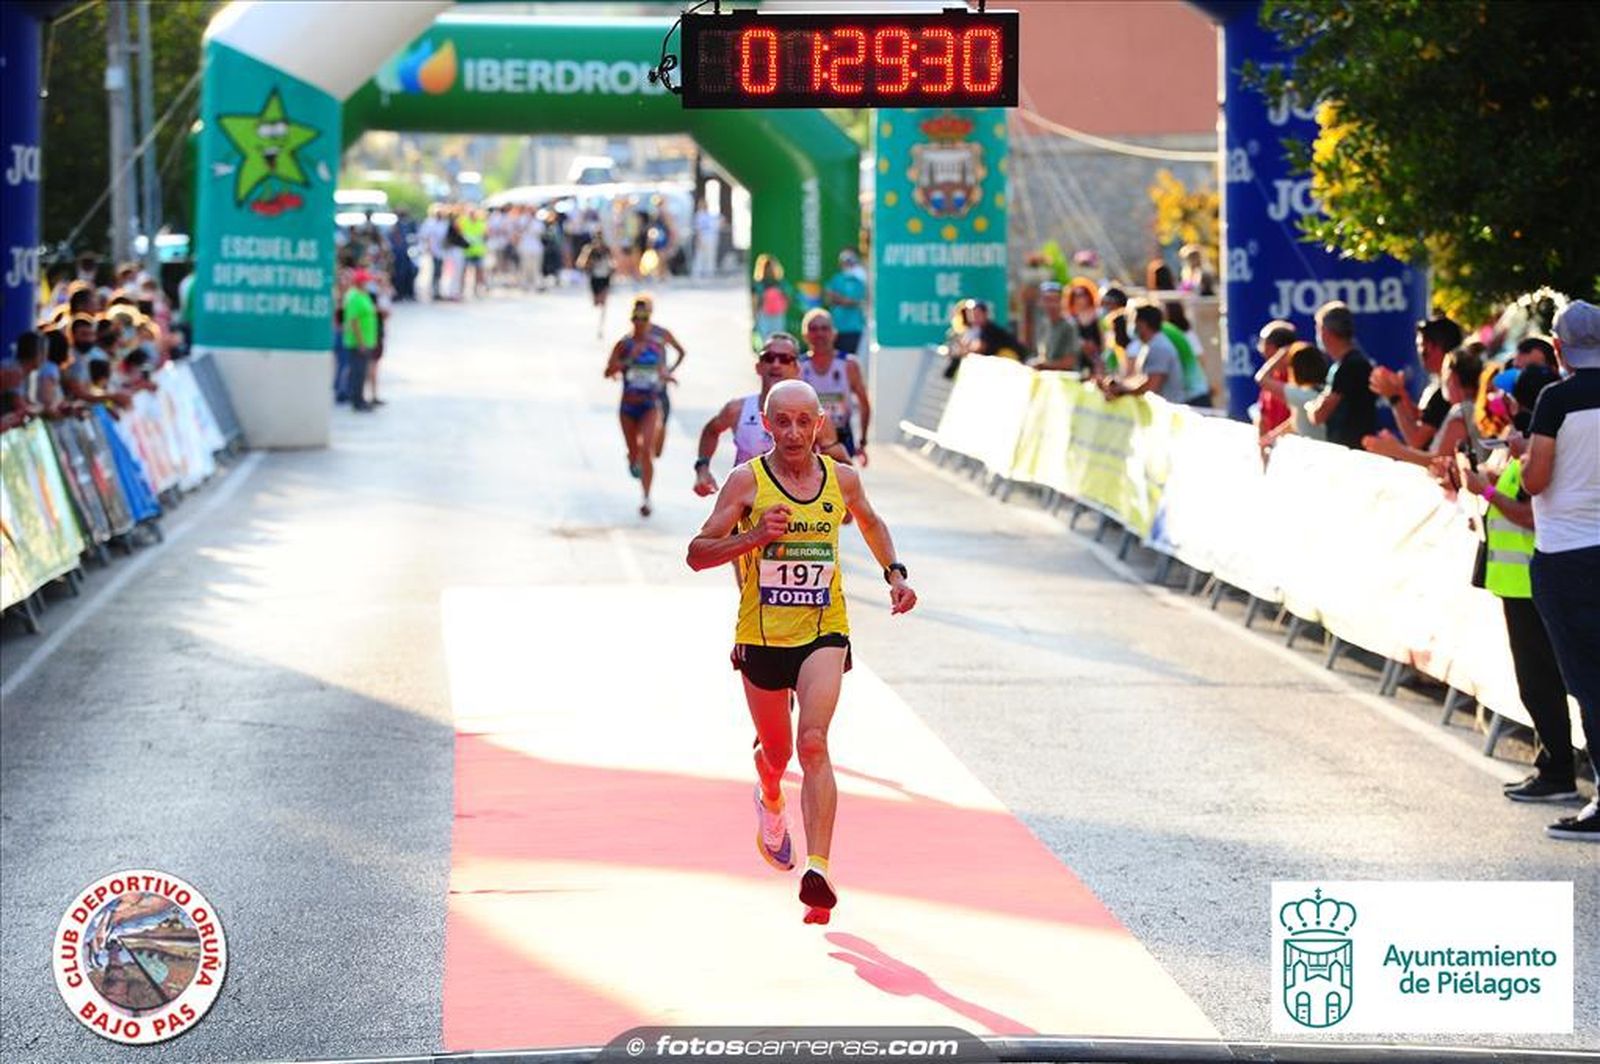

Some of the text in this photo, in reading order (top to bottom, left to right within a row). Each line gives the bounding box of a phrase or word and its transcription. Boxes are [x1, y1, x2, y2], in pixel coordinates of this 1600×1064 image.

[220, 235, 319, 261] ESCUELAS
[883, 243, 1007, 268] AYUNTAMIENT
[776, 563, 825, 587] 197
